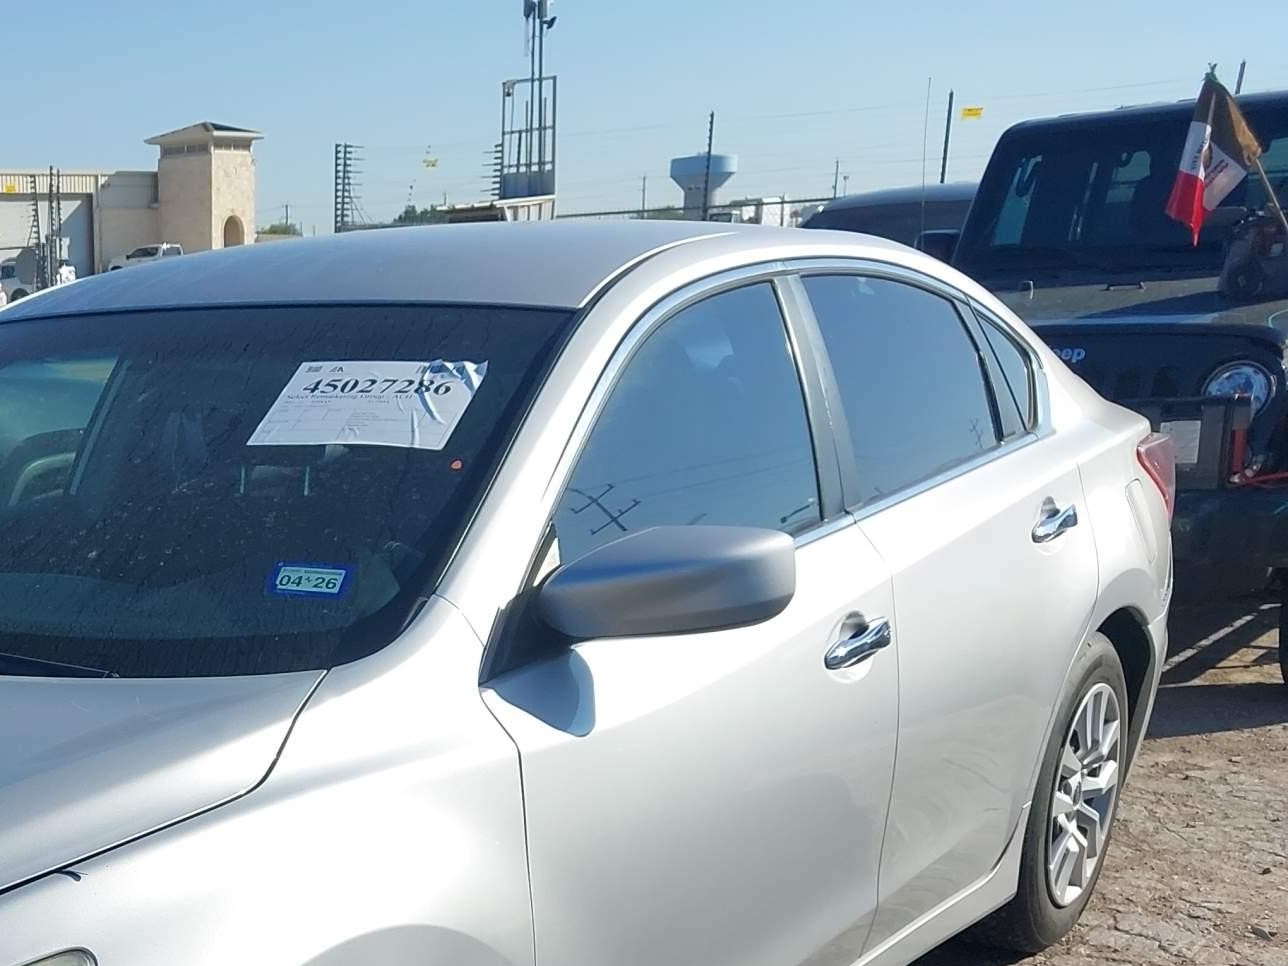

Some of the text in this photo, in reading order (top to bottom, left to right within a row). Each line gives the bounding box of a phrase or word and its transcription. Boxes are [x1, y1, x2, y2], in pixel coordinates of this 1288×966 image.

[1052, 347, 1086, 363] eep
[303, 378, 453, 395] 45027286
[279, 574, 339, 590] 04 26
